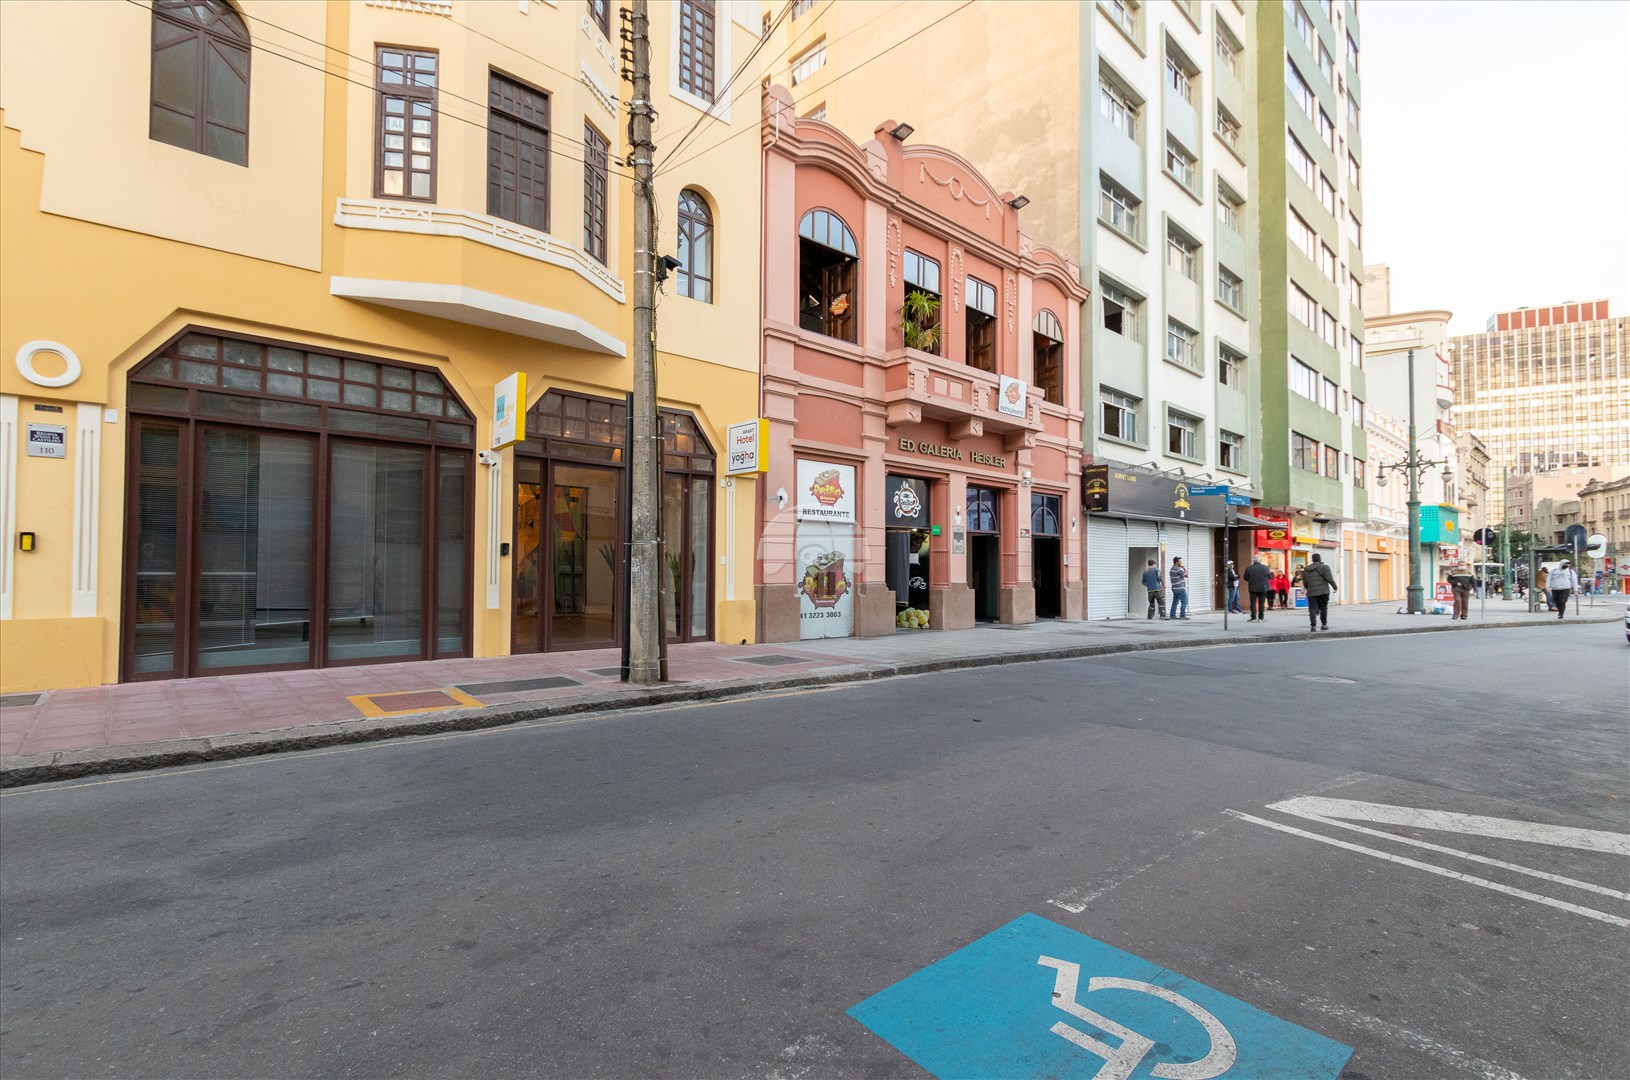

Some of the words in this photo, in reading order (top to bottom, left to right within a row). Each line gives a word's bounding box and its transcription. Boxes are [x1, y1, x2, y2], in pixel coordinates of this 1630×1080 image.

[1000, 405, 1024, 417] RESTAURANTE
[736, 433, 754, 445] Hotel
[40, 447, 55, 455] 110
[899, 437, 917, 452] ED.
[919, 441, 963, 460] GALERIA
[970, 451, 1006, 468] HEISLER
[731, 450, 755, 465] yogha
[802, 508, 850, 518] RESTAURANTE
[808, 611, 824, 619] 3223
